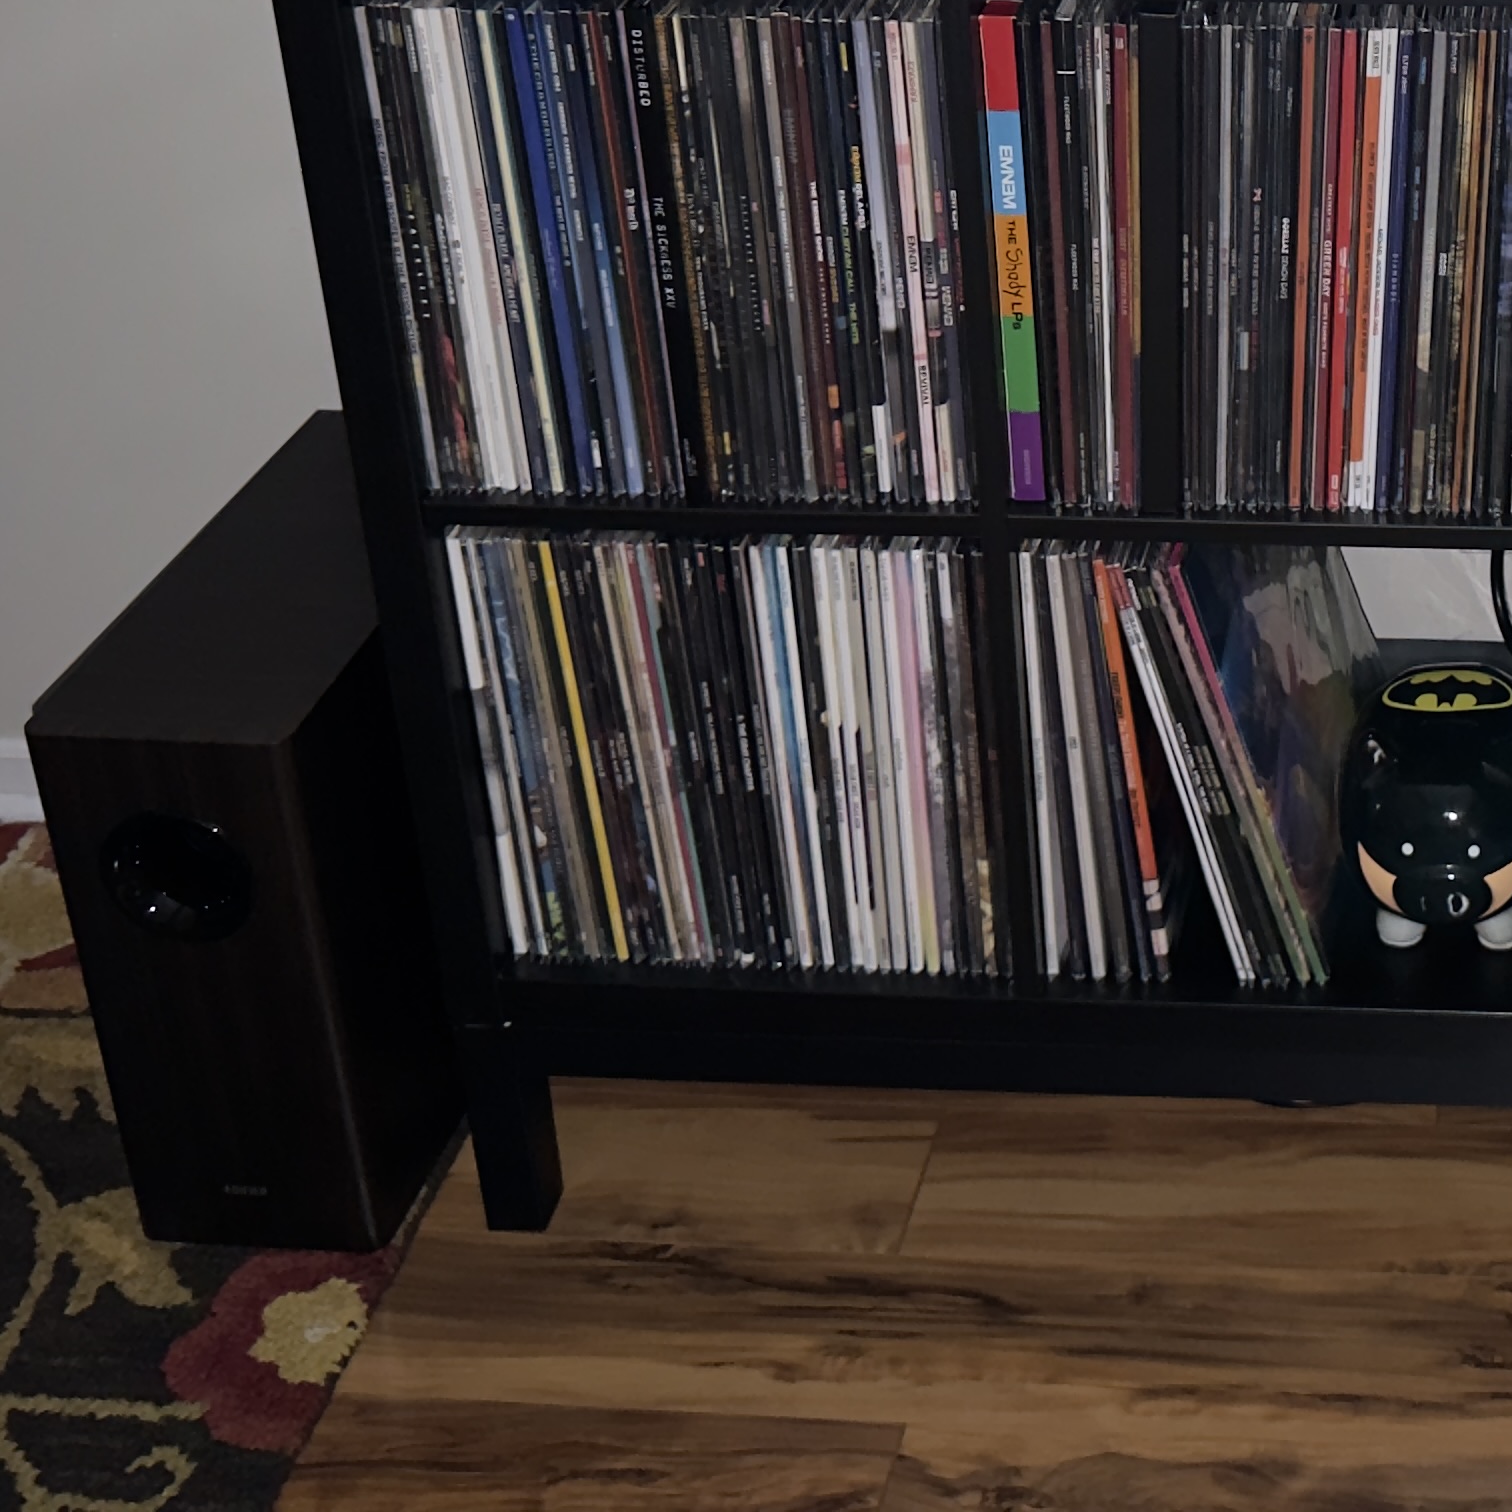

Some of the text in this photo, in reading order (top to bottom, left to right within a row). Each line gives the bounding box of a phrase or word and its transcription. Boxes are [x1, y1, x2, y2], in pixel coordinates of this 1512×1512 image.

[1401, 54, 1409, 75] ELTON
[652, 196, 666, 217] THE
[1006, 219, 1016, 245] THE
[1322, 239, 1331, 275] GREEN
[1000, 247, 1026, 298] Shady
[1321, 277, 1330, 297] DAY
